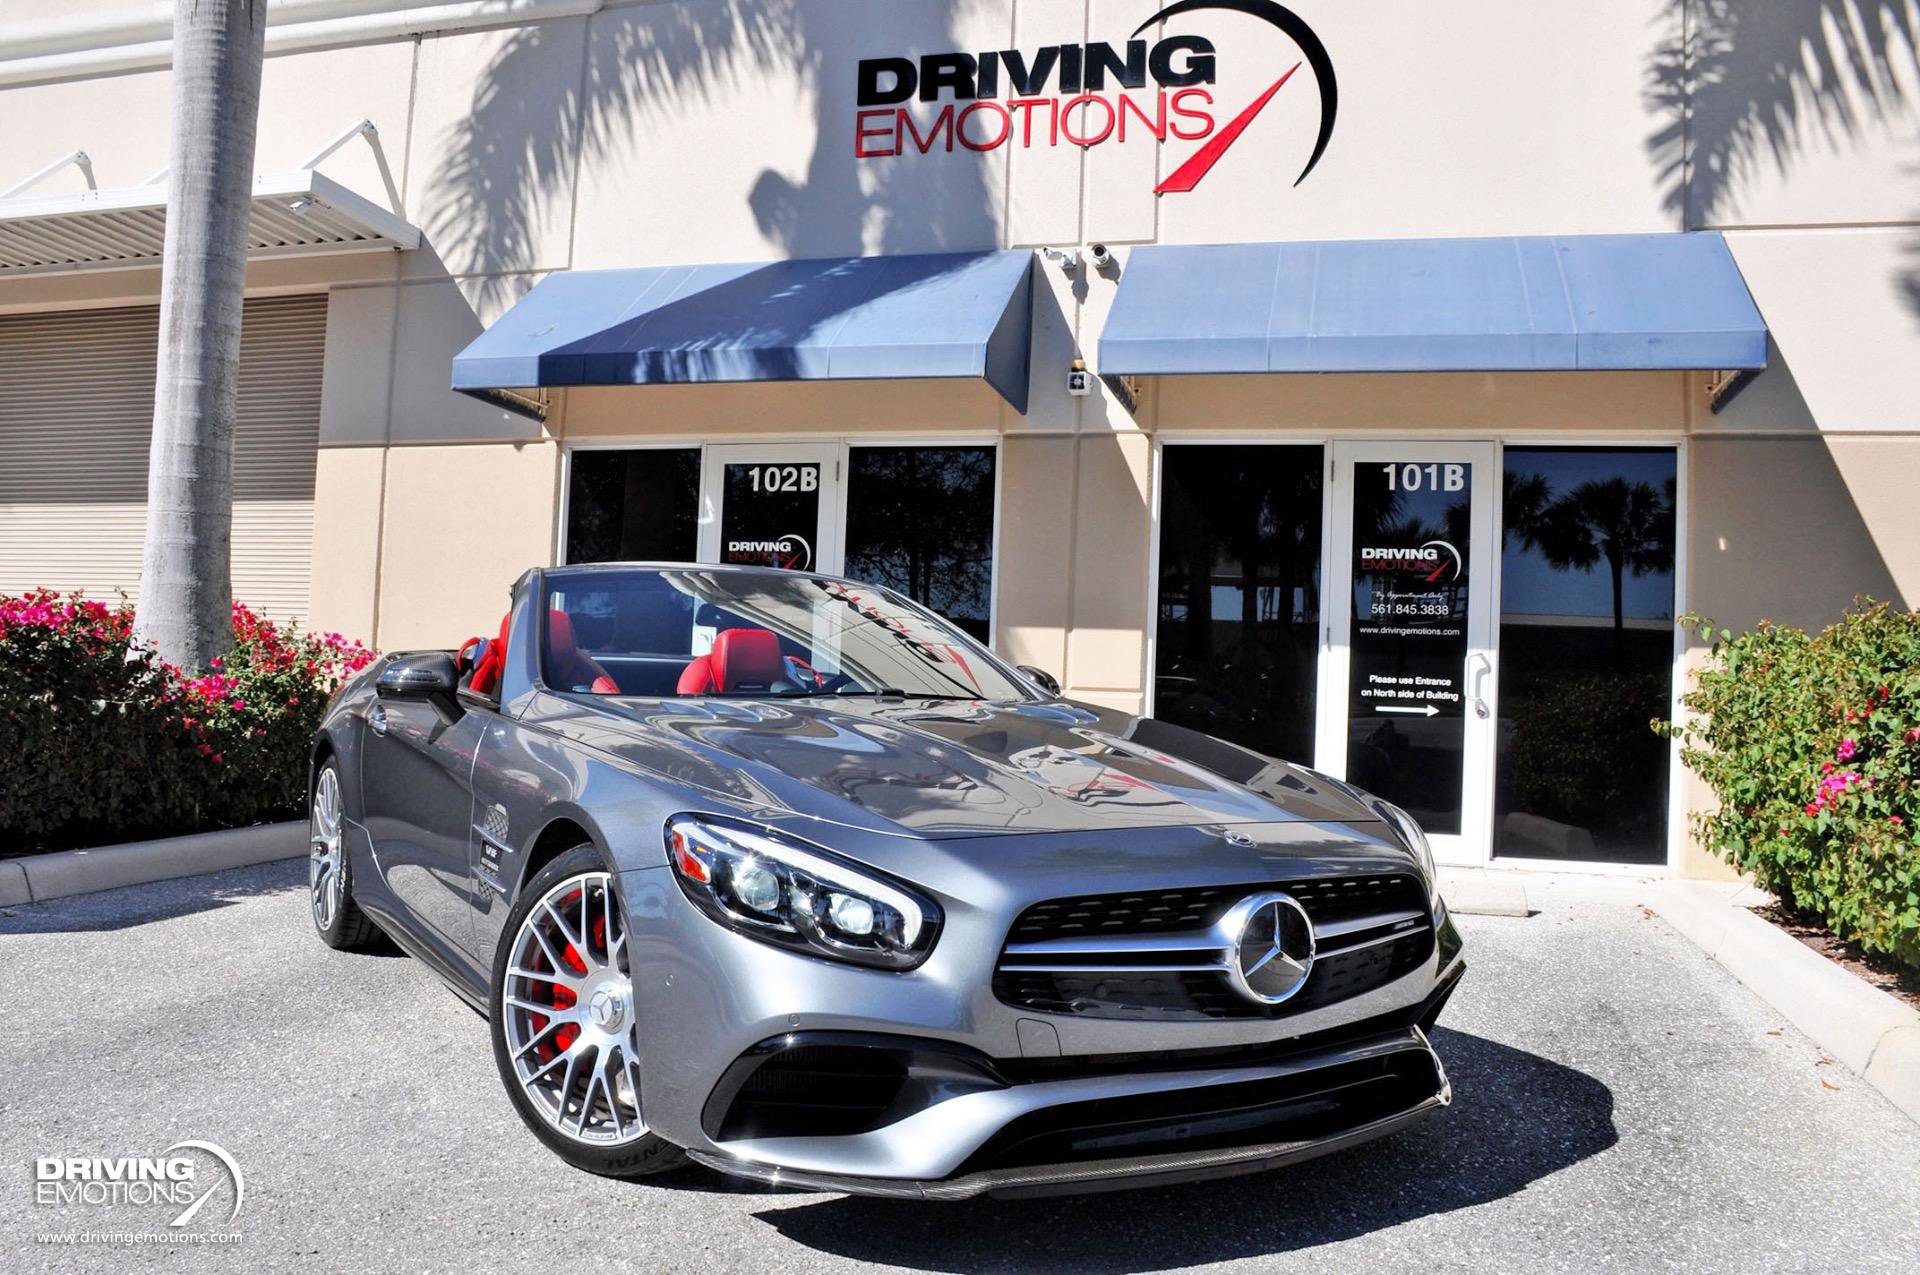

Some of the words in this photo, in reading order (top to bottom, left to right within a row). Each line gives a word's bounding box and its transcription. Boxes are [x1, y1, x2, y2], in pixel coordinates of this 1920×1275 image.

[857, 35, 1216, 106] DRIVING
[855, 88, 1215, 158] EMOTIONS
[748, 466, 818, 492] 102B
[1383, 464, 1464, 491] 101B
[728, 541, 792, 552] DRIVING
[1361, 548, 1438, 560] DRIVING
[1361, 560, 1440, 571] EMOTIONS
[1371, 603, 1449, 615] 561.845.3838
[1360, 627, 1460, 636] www.drivingemotions.com
[1369, 674, 1397, 684] Please
[1415, 676, 1452, 686] Entrance
[1373, 688, 1396, 697] North
[1398, 690, 1415, 698] side
[1416, 690, 1425, 698] of
[1426, 690, 1459, 702] Building
